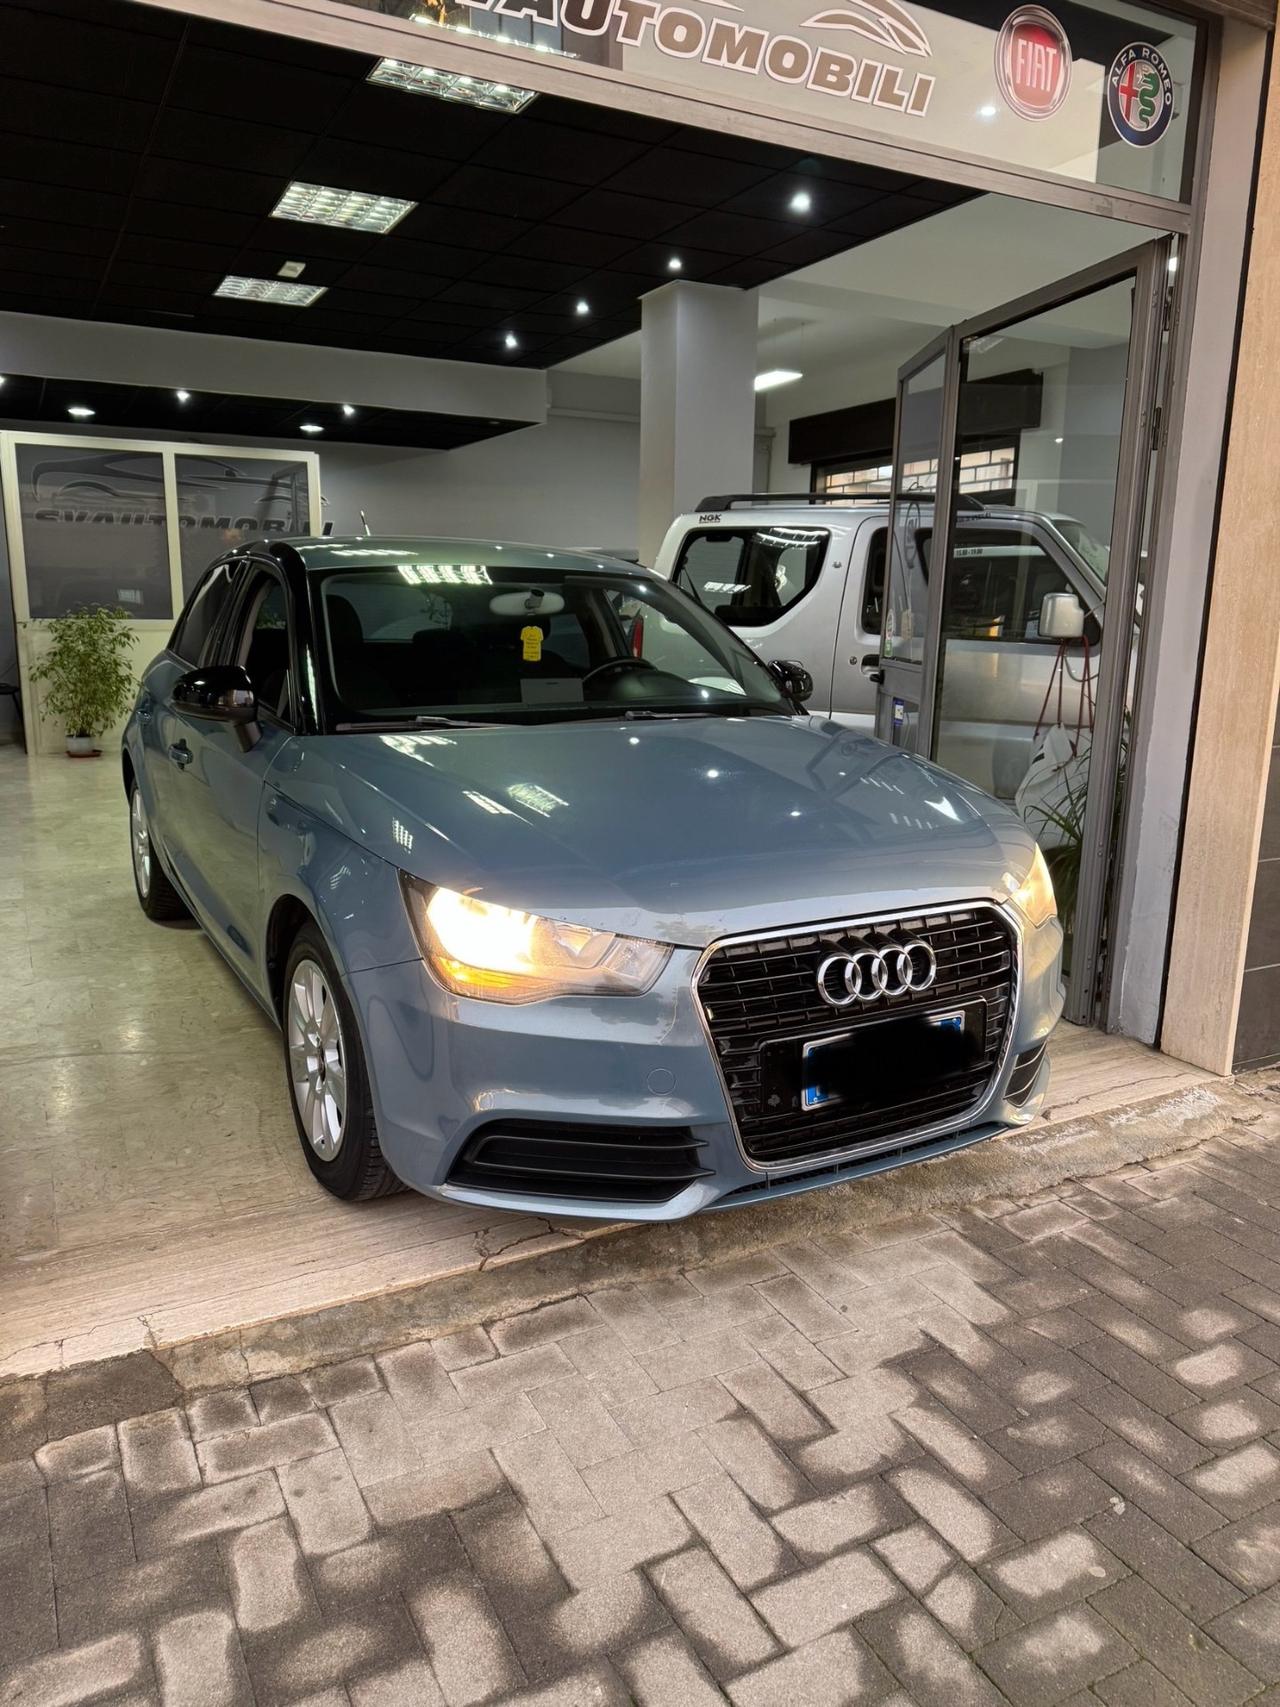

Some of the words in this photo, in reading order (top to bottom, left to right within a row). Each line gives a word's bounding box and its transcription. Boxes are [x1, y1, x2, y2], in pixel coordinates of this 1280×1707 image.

[455, 0, 935, 117] AUTOMOBILI
[1016, 38, 1057, 92] FIAT
[1111, 49, 1137, 88] ALFA
[1142, 47, 1172, 106] ROMEO
